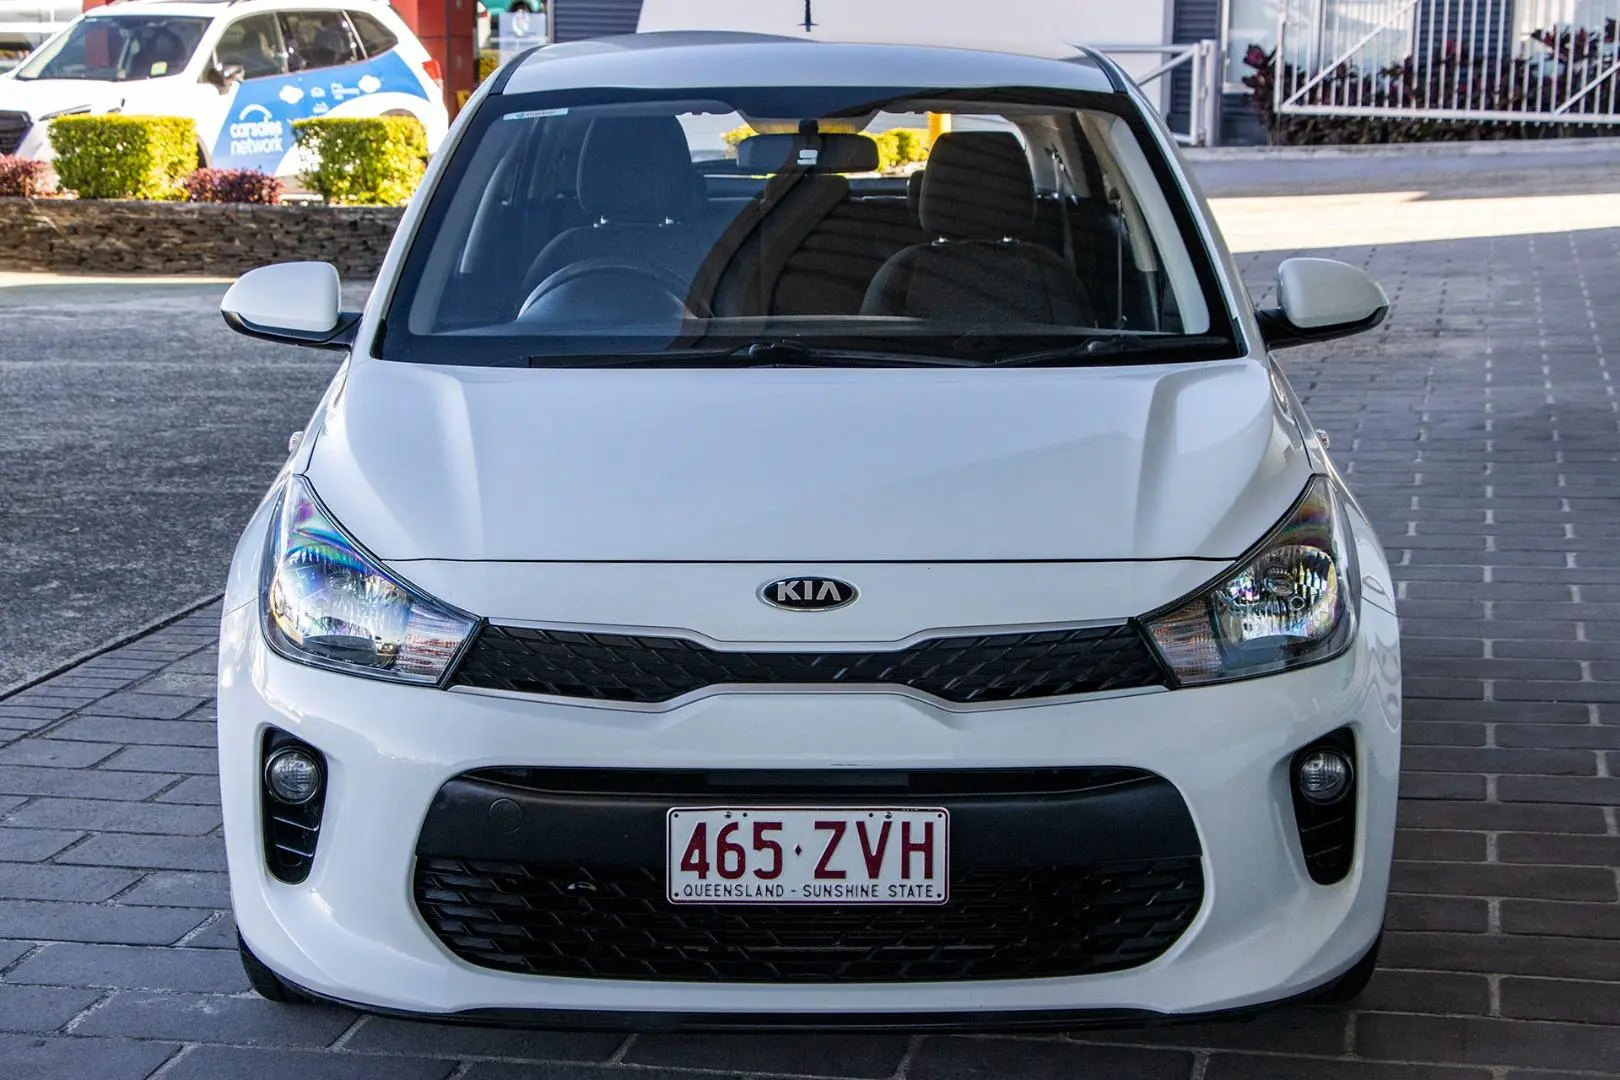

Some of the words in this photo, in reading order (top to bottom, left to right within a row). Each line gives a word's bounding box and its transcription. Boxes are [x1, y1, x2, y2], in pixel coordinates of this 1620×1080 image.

[230, 136, 283, 155] network
[777, 580, 842, 602] KIA
[680, 821, 785, 880] 465
[813, 821, 934, 880] ZVH
[683, 884, 786, 898] QUEENSLAND
[802, 884, 880, 898] SUNSHINE
[887, 884, 933, 898] STATE
